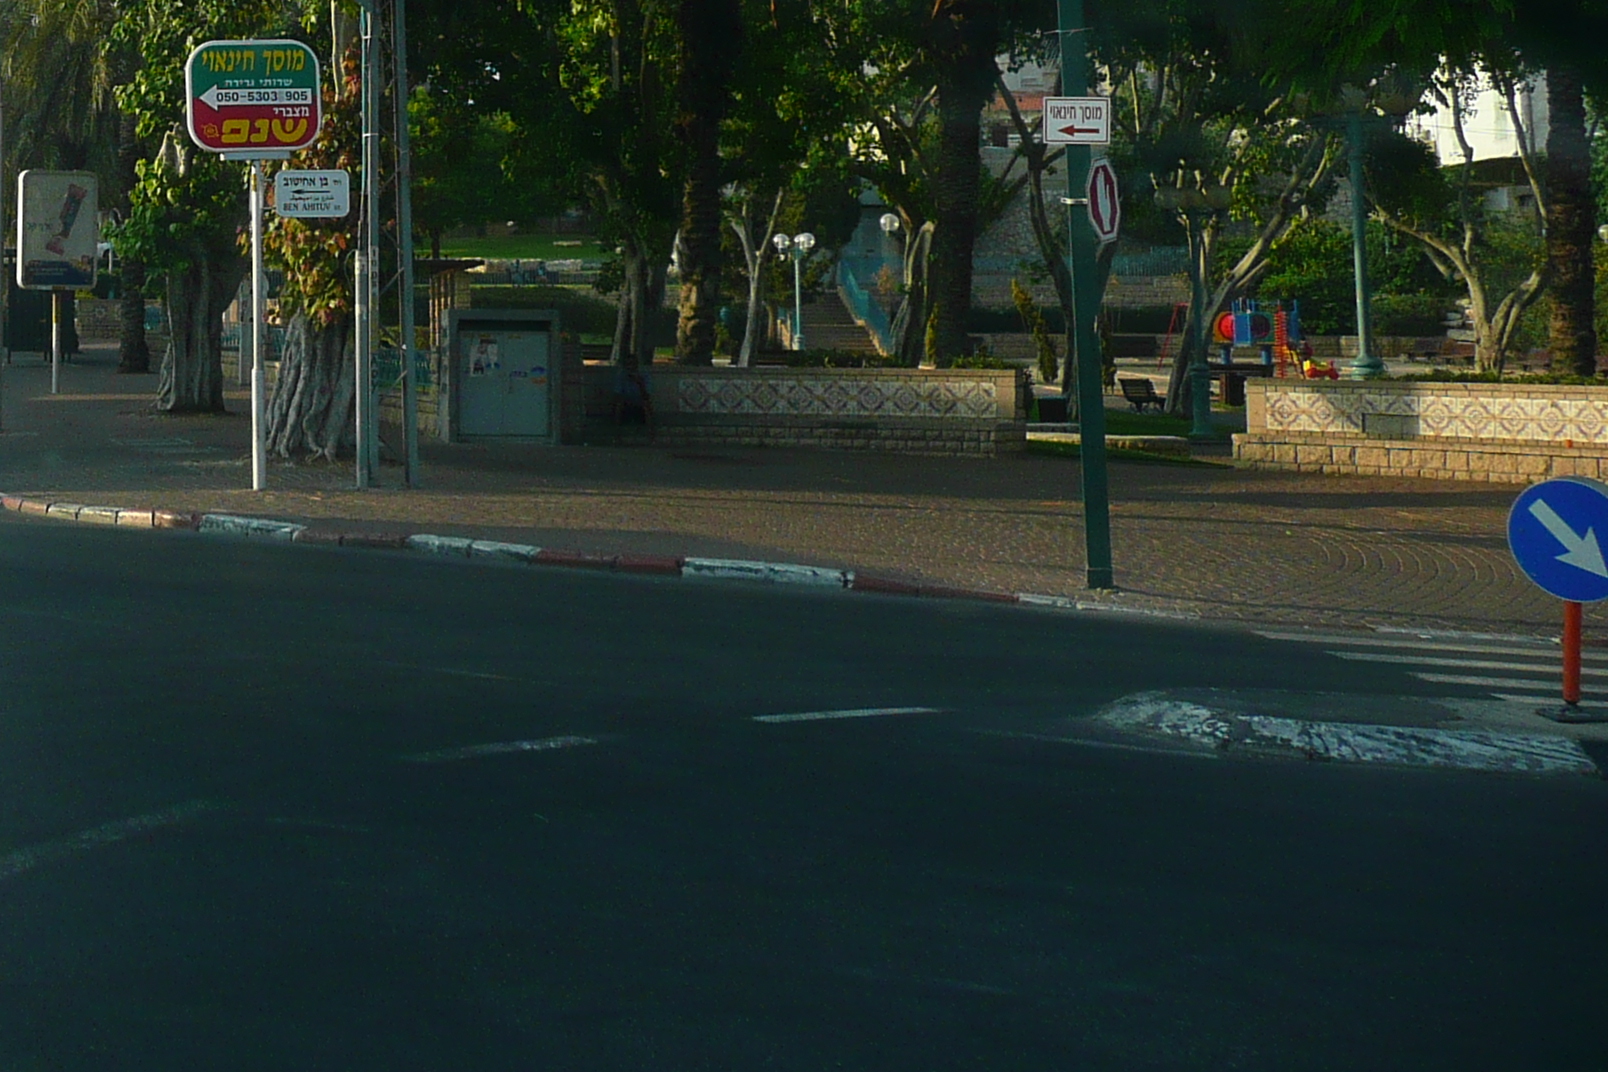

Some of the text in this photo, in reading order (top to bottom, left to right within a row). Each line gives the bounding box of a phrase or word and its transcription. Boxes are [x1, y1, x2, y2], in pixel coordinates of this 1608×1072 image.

[203, 49, 305, 75] מוסך חינאוי
[224, 79, 293, 87] שרותי גרירה
[216, 91, 308, 102] 050-5303 905
[273, 107, 309, 116] מצברי
[1050, 106, 1102, 123] מוסך חינאוי
[283, 202, 299, 211] BEN
[302, 202, 331, 211] AHITUV
